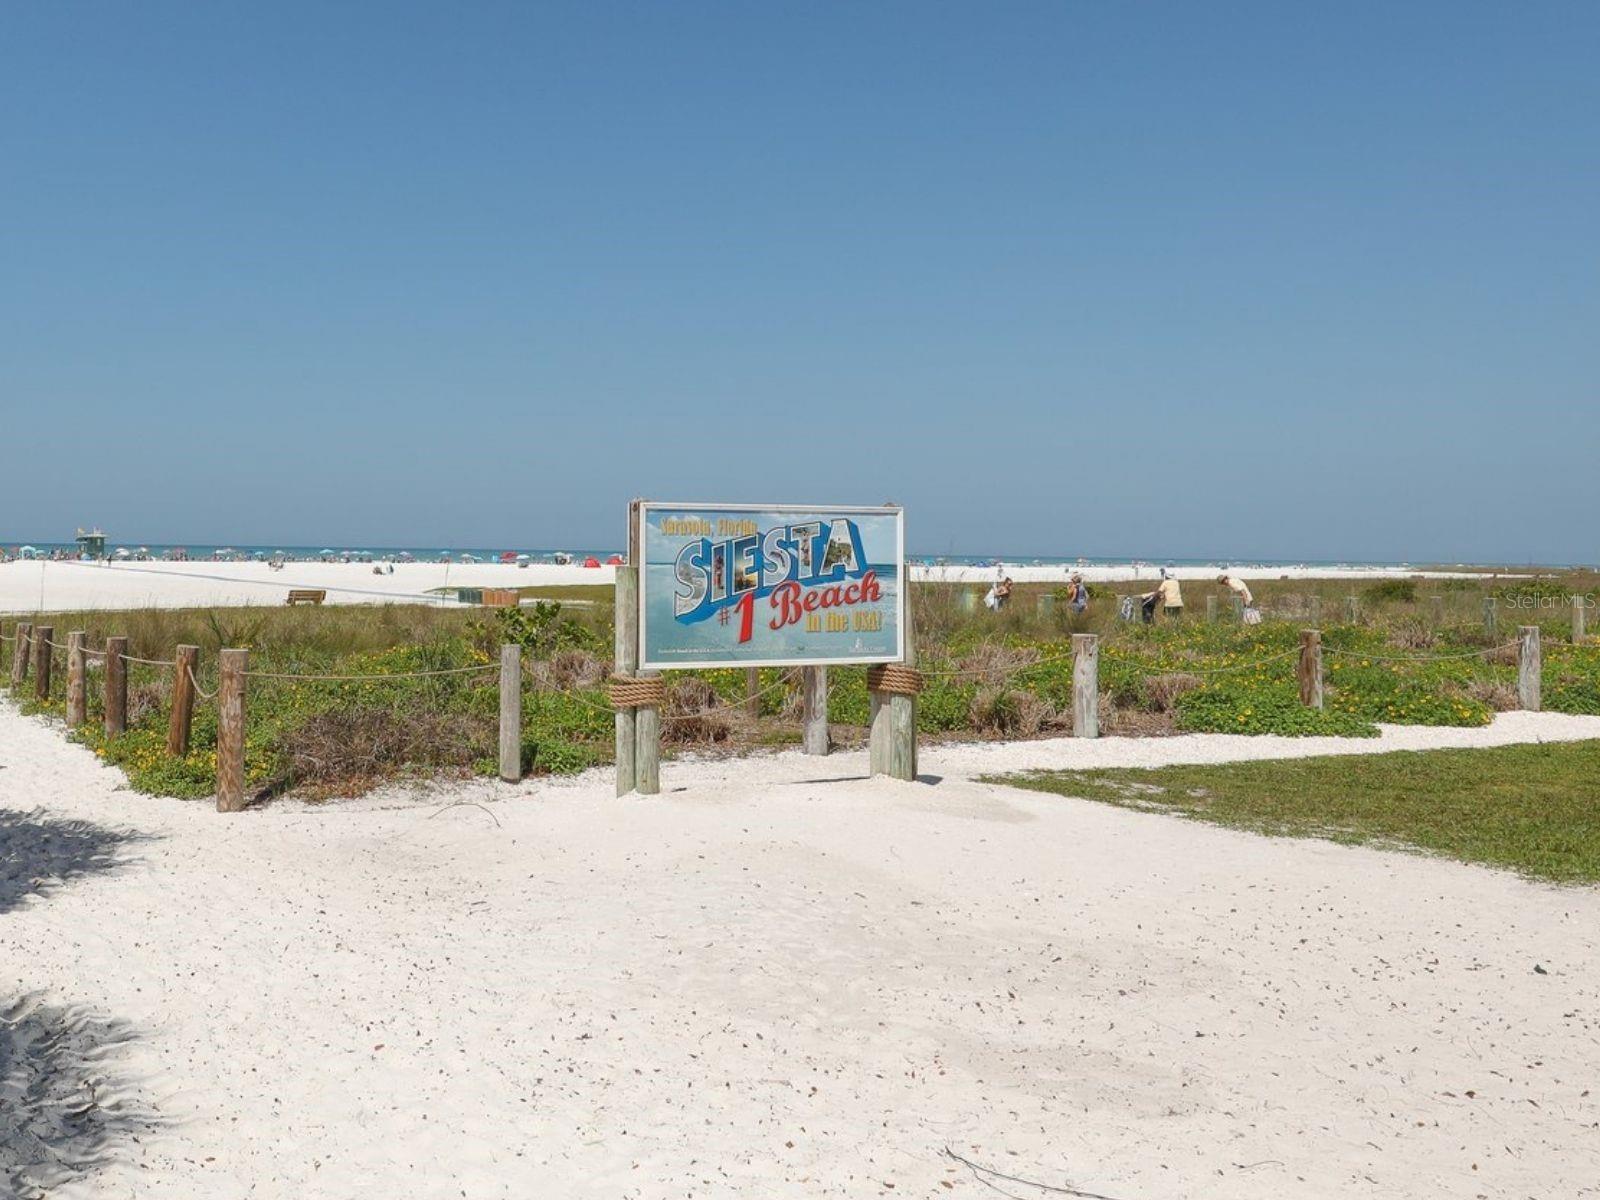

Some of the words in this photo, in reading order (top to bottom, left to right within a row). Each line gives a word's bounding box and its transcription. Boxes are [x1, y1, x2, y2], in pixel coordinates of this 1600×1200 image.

[718, 517, 758, 536] Florida
[674, 518, 867, 623] SIESTA
[718, 591, 754, 644] #1
[769, 570, 883, 630] Beach
[806, 612, 821, 632] in
[825, 612, 848, 632] the
[853, 610, 883, 632] USA!
